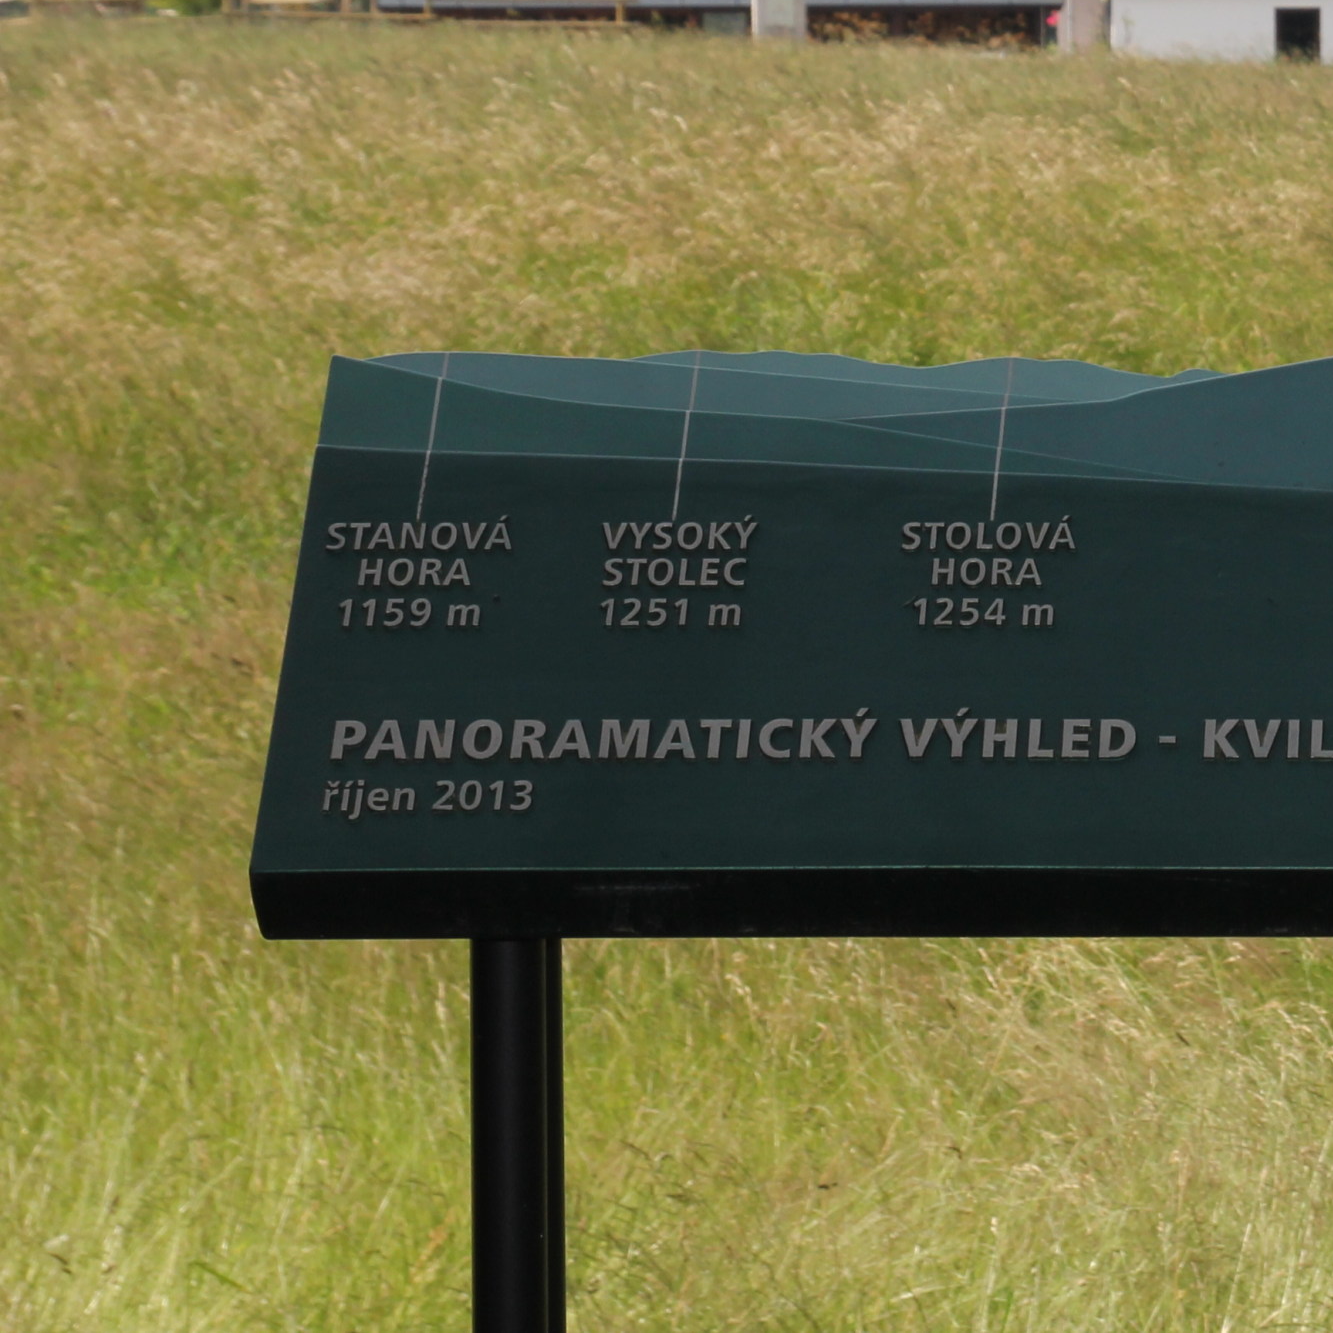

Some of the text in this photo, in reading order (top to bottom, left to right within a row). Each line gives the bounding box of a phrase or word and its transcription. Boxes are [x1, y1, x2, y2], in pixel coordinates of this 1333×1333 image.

[325, 514, 513, 552] STANOVÁ
[602, 514, 758, 551] VYSOKÝ
[901, 514, 1077, 552] STOLOVÁ
[357, 556, 472, 587] HORA
[602, 556, 748, 587] STOLEC
[931, 556, 1043, 587] HORA
[338, 597, 482, 628] 1159 m
[600, 597, 742, 627] 1251 m
[914, 597, 1055, 627] 1254 m
[330, 708, 878, 760] PANORAMATICKÝ
[900, 708, 1137, 759] VÝHLED
[322, 778, 534, 820] říjen 2013
